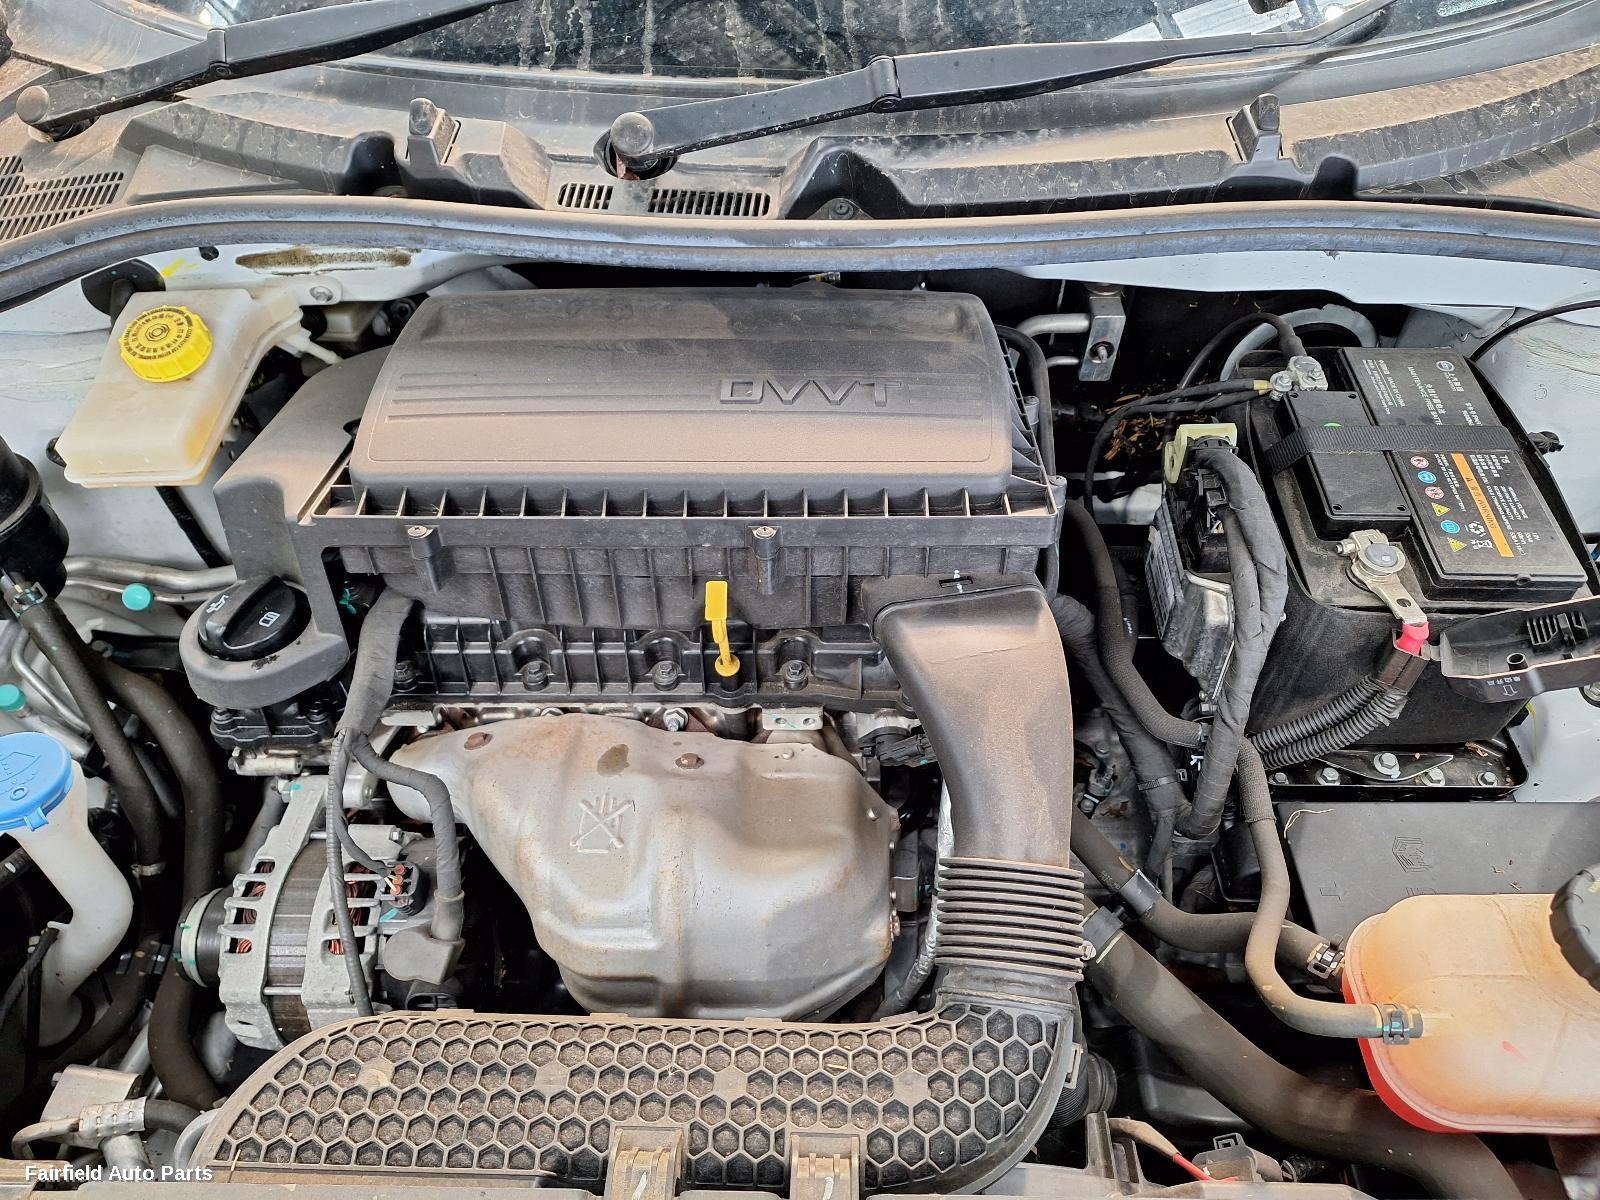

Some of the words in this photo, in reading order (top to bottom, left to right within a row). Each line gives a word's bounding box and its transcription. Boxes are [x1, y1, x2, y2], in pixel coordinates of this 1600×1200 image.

[720, 379, 902, 407] DVVT
[1385, 376, 1398, 388] MADE
[1393, 393, 1406, 407] CHINA
[1406, 366, 1429, 397] MAINTENANCE
[1422, 397, 1436, 411] FREE
[1428, 410, 1444, 426] BATTE
[1476, 499, 1498, 529] WARNING
